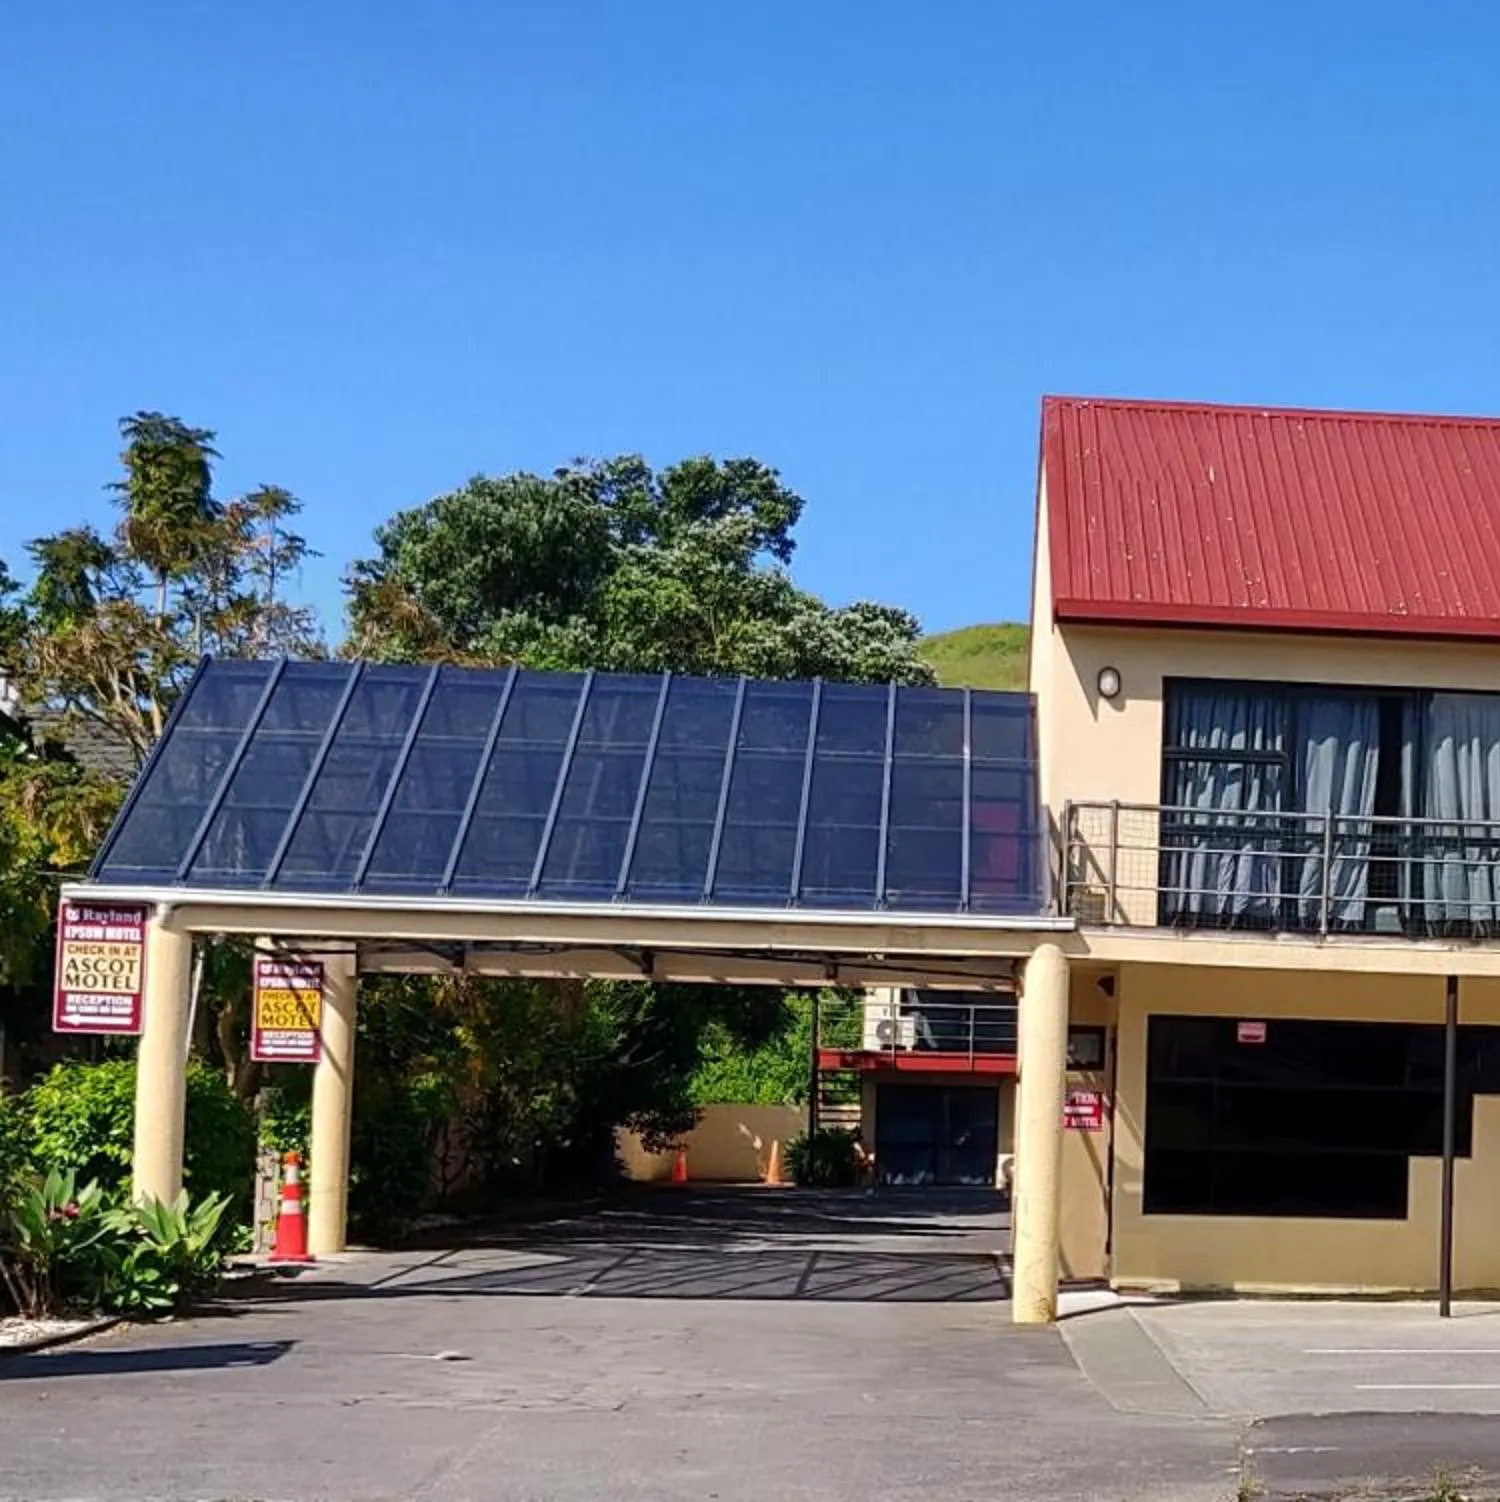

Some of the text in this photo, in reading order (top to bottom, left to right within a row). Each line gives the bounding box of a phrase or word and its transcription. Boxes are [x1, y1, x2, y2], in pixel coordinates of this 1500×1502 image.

[83, 908, 142, 926] Rayland
[67, 943, 138, 956] CHECK IN AT
[66, 957, 138, 975] ASCOT
[65, 972, 136, 990] MOTEL
[261, 1001, 318, 1014] ASCOT
[261, 1014, 317, 1028] MOTEL
